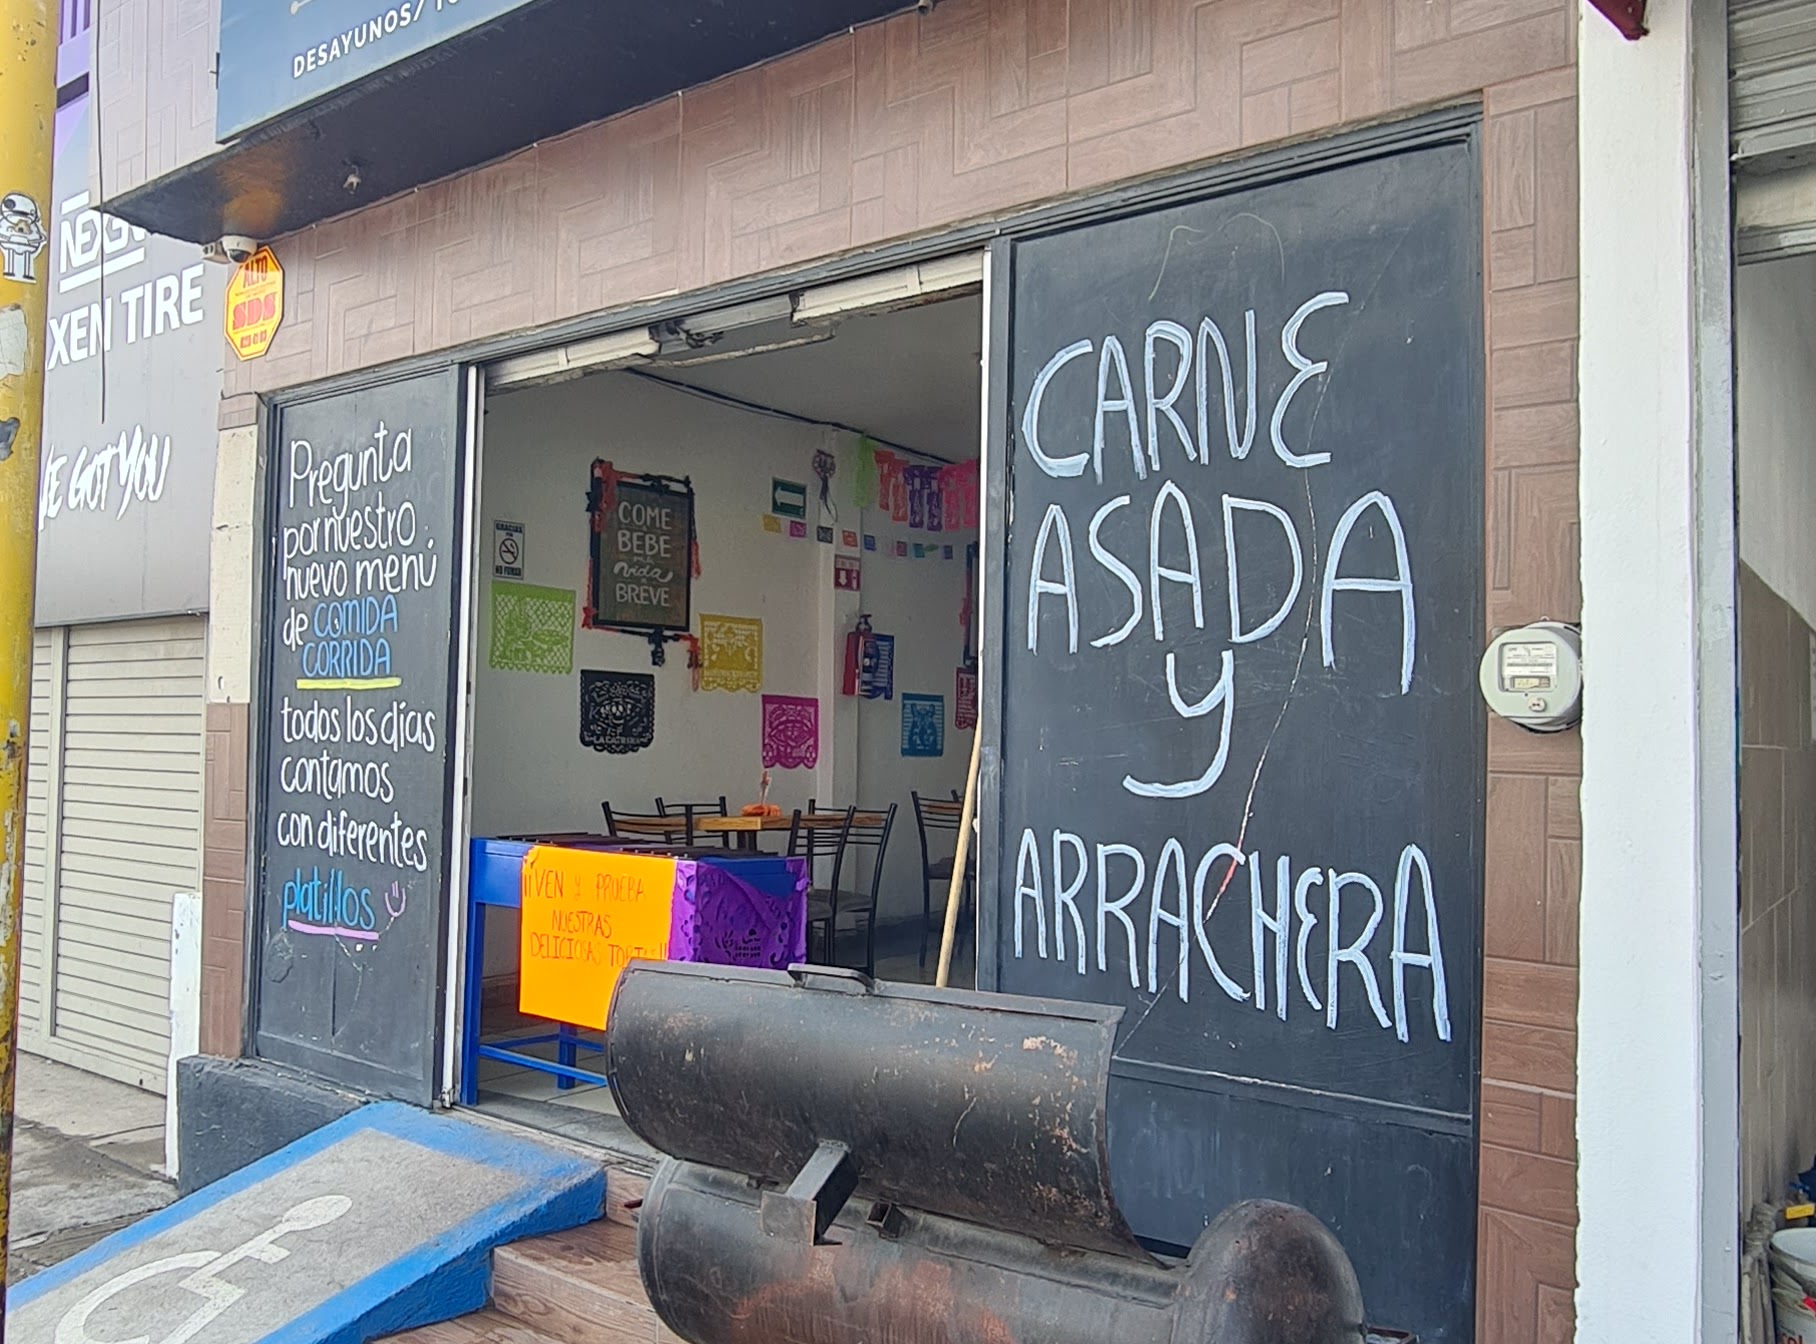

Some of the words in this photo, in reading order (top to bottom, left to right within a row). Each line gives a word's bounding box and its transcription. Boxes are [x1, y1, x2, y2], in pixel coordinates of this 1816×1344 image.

[243, 255, 268, 288] ALTO
[120, 262, 205, 344] TIRE
[232, 292, 279, 331] SDS
[1021, 290, 1350, 484] CARNE
[117, 424, 171, 521] YOU
[289, 420, 412, 520] Pregunta
[617, 529, 672, 558] BEBE
[618, 501, 673, 530] COME
[286, 559, 348, 601] nuevo
[355, 537, 437, 595] menú
[615, 583, 671, 607] BREVE
[1027, 480, 1417, 694] ASADA
[282, 606, 308, 652] de
[314, 593, 399, 639] COMIDA
[302, 637, 393, 678] CORRIDA
[281, 696, 341, 744] todos
[346, 695, 379, 746] los
[381, 700, 436, 752] días
[280, 749, 394, 803] contamos
[277, 812, 313, 848] con
[317, 809, 428, 872] diferentes
[282, 865, 376, 931] platillos
[551, 909, 612, 938] NUESTRAS
[1014, 828, 1452, 1043] ARRACHERA
